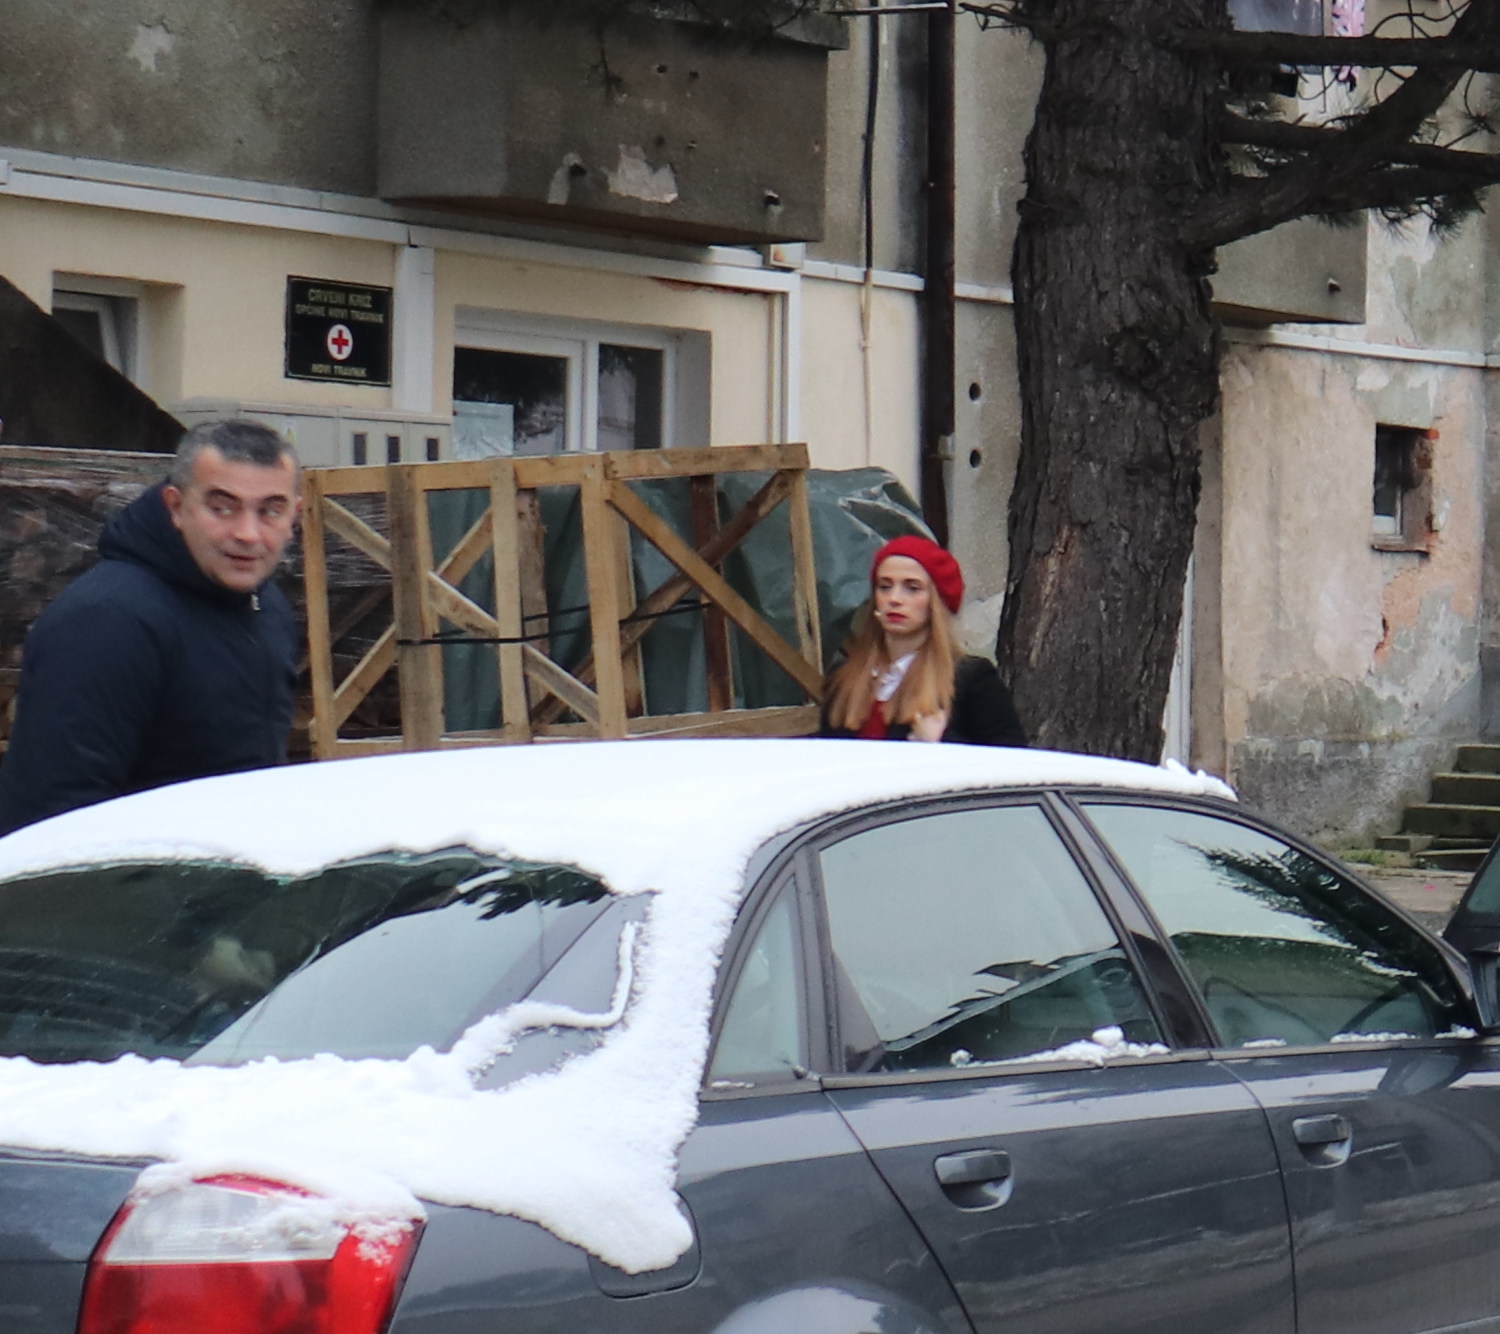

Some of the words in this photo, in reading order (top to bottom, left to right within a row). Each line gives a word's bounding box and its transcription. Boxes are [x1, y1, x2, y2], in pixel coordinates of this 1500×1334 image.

[309, 289, 346, 304] CRVENI
[329, 307, 348, 319] NOVI
[350, 310, 384, 323] TRAVNIK
[311, 363, 331, 374] NOVI
[333, 365, 366, 378] TRAVNIK
